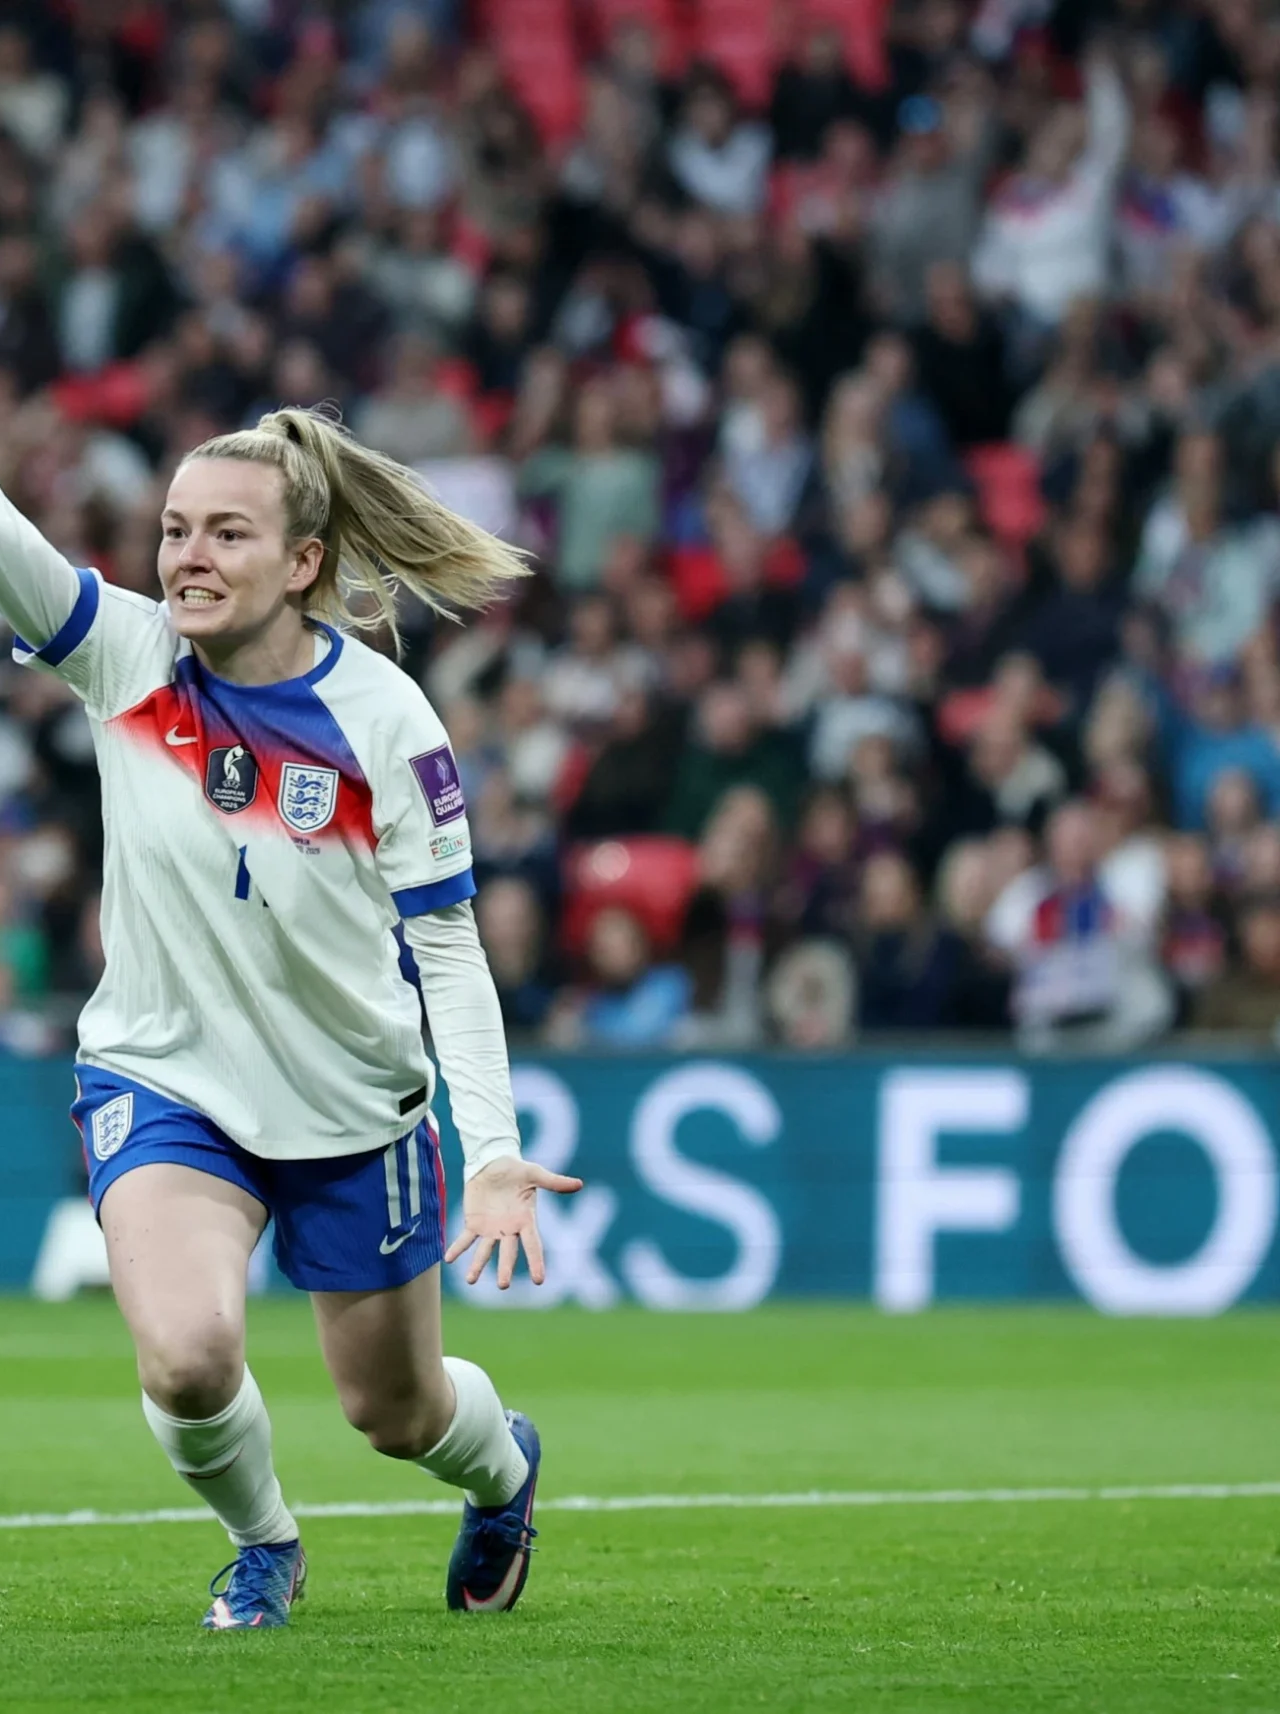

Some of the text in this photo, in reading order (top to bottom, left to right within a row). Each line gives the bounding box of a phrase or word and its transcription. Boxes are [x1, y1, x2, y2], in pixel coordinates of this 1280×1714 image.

[214, 788, 246, 797] EUROPEAN
[431, 839, 464, 858] FOUN
[248, 1060, 782, 1312] &S
